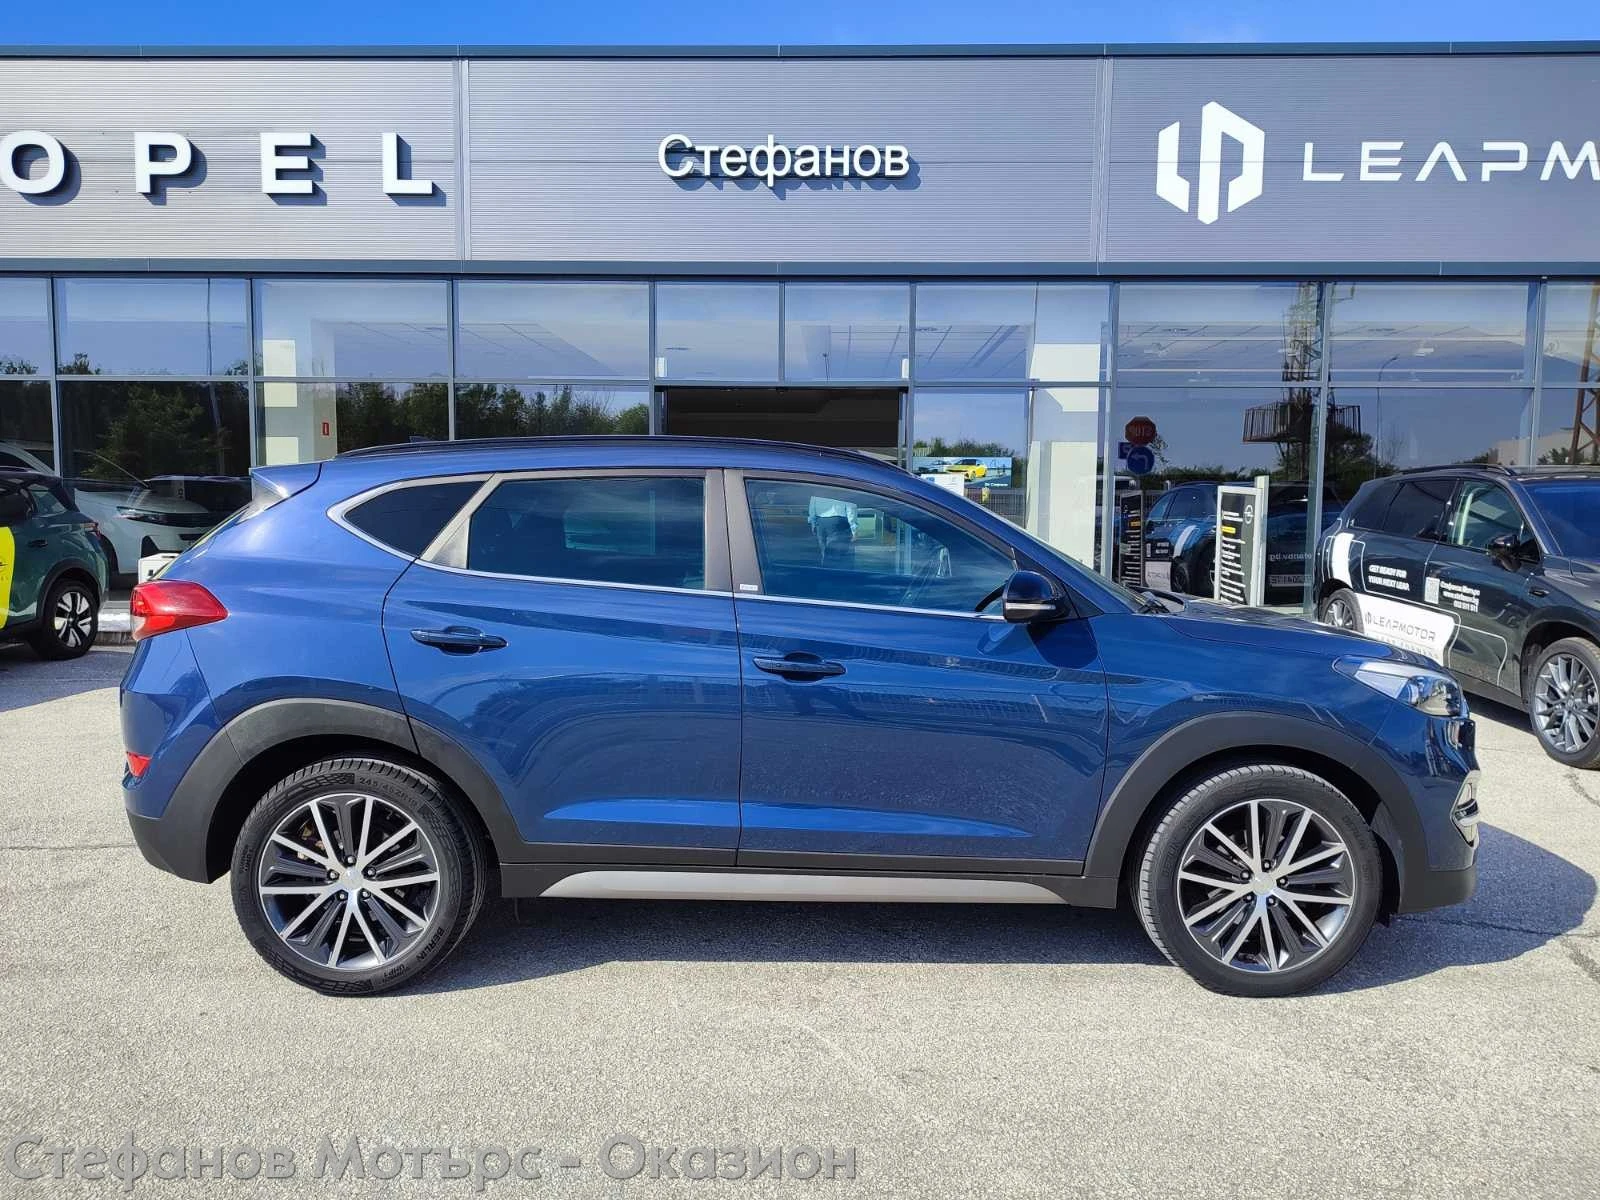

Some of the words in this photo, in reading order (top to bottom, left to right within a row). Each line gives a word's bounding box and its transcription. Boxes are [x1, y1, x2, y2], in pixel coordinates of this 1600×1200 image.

[0, 130, 433, 194] OPEL
[658, 134, 910, 187] Стефанов
[1303, 141, 1600, 181] LEAPM
[1373, 615, 1436, 641] LEAPMOTOR
[416, 927, 444, 961] BERLIN
